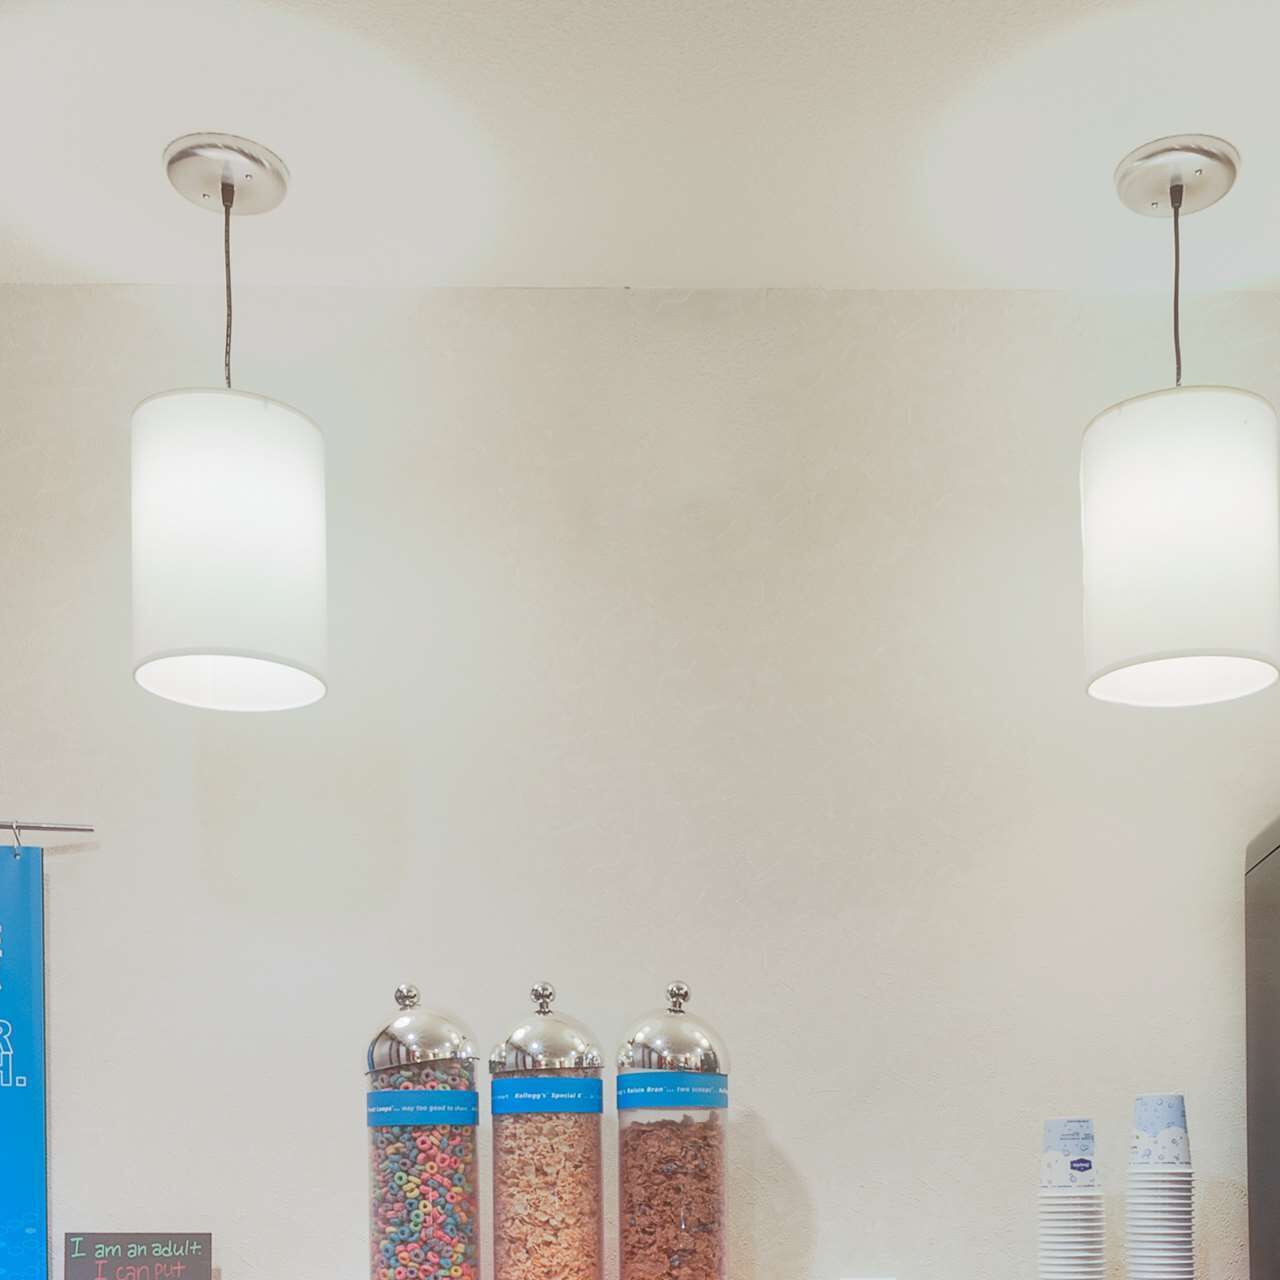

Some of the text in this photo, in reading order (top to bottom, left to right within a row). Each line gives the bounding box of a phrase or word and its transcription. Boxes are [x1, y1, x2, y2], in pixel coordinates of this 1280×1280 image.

[71, 1237, 86, 1257] I
[95, 1244, 122, 1258] am
[127, 1243, 147, 1258] an
[95, 1260, 108, 1280] I
